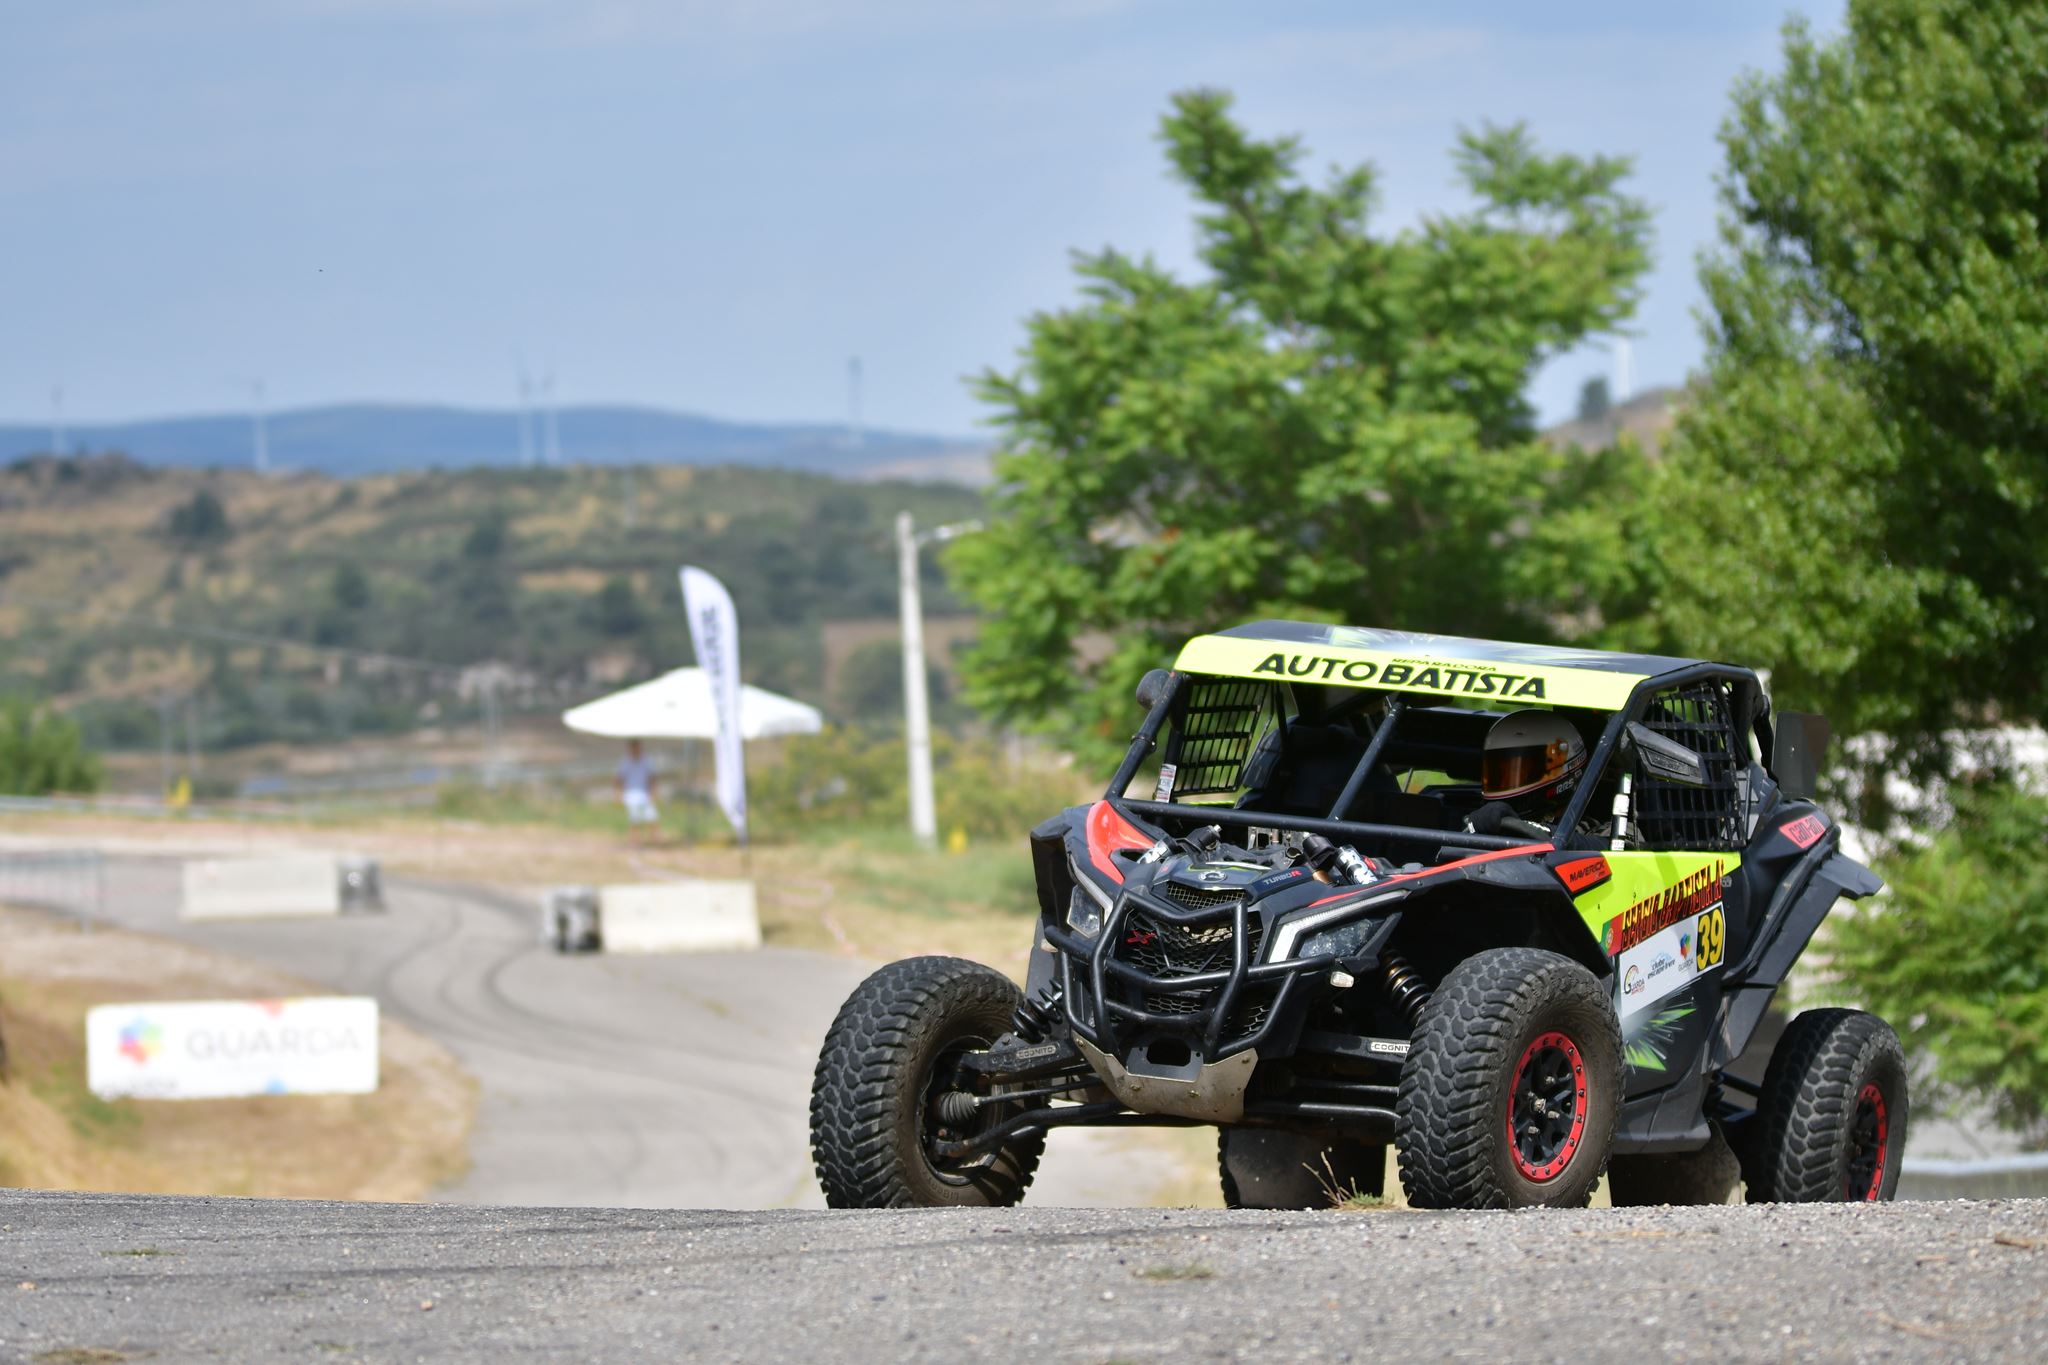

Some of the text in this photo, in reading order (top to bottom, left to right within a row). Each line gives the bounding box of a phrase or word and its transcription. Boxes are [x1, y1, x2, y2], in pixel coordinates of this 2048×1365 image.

[1391, 657, 1497, 672] REPARADORA
[1569, 860, 1605, 883] MAVERICK
[1697, 908, 1724, 971] 39
